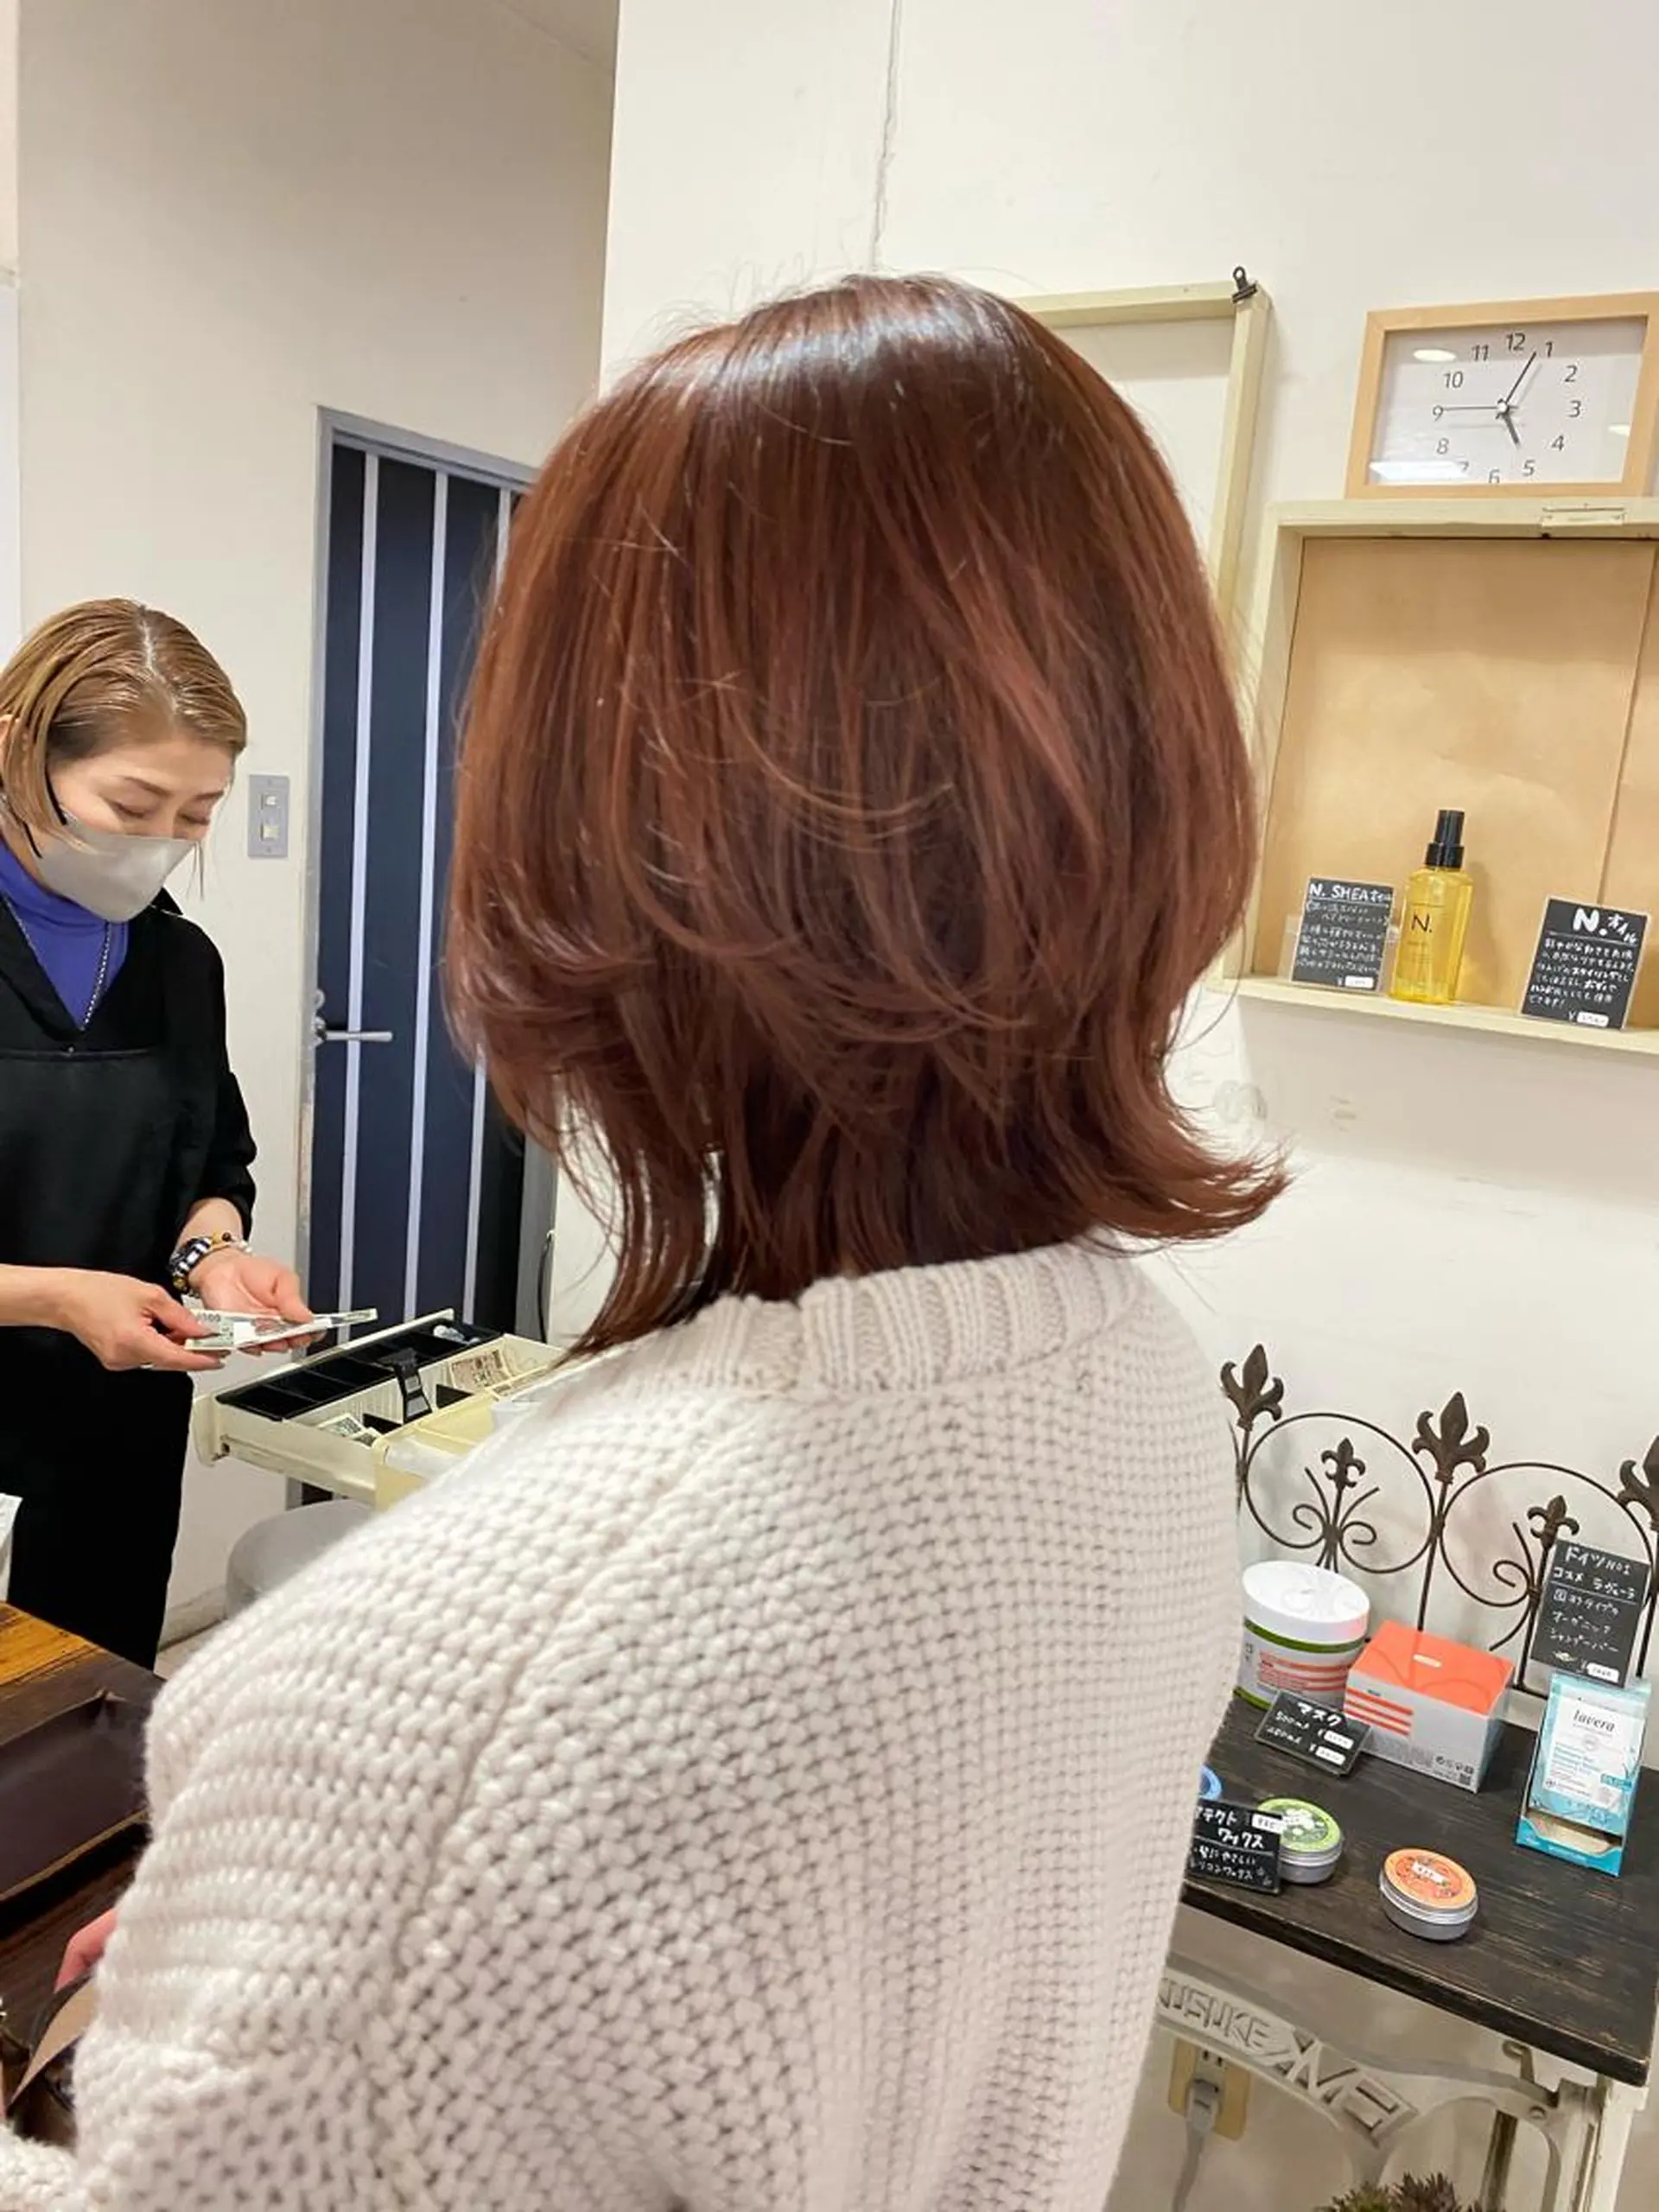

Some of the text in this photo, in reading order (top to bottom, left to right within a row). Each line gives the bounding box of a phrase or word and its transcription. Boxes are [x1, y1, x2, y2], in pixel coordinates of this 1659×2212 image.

[1506, 333, 1526, 352] 12
[1545, 341, 1554, 358] 1
[1471, 345, 1490, 361] 11
[1444, 372, 1464, 388] 10
[1565, 365, 1578, 383] 2
[1433, 406, 1444, 422] 9
[1569, 400, 1582, 417] 3
[1436, 438, 1449, 455] 8
[1551, 435, 1565, 452] 4
[1489, 469, 1500, 484] 6
[1523, 460, 1535, 476] 5
[1297, 1702, 1342, 1726] マスク
[1573, 1708, 1616, 1732] lavera
